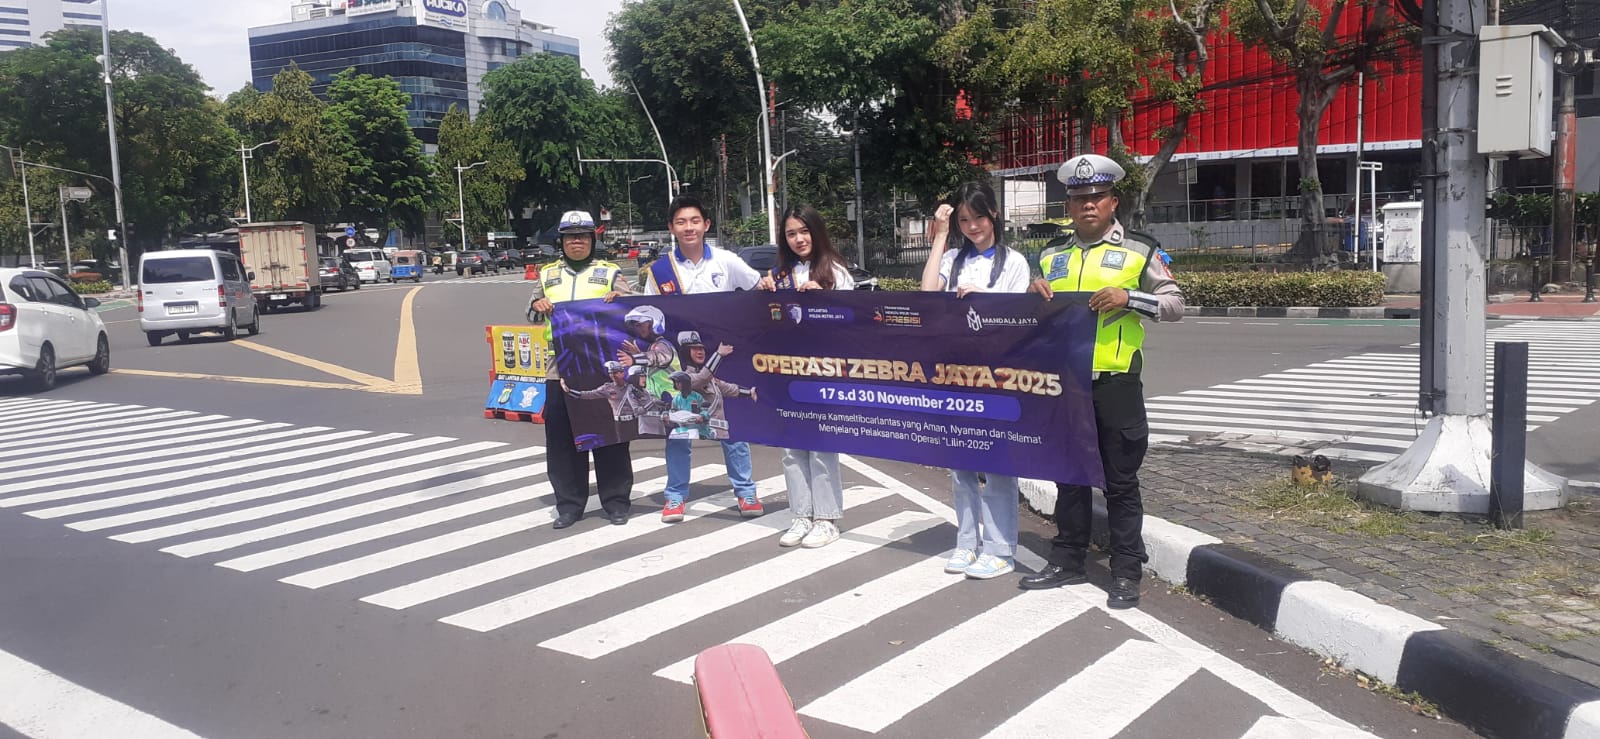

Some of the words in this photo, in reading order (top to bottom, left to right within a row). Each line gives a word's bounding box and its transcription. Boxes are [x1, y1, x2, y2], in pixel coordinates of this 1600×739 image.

[885, 316, 921, 324] PRESISI
[752, 353, 848, 378] OPERASI
[848, 358, 928, 383] ZEBRA
[931, 363, 998, 389] JAYA
[994, 367, 1063, 397] 2025
[819, 387, 836, 400] 17
[838, 388, 856, 401] s.d
[858, 389, 875, 402] 30
[877, 391, 943, 410] November
[946, 398, 985, 413] 2025
[818, 423, 859, 437] Menjelang
[860, 427, 909, 441] Pelaksanaan
[910, 432, 941, 445] Operasi
[902, 420, 922, 431] yang
[923, 421, 948, 434] Aman,
[950, 424, 988, 438] Nyaman
[989, 429, 1006, 440] dan
[1007, 431, 1043, 445] Selamat
